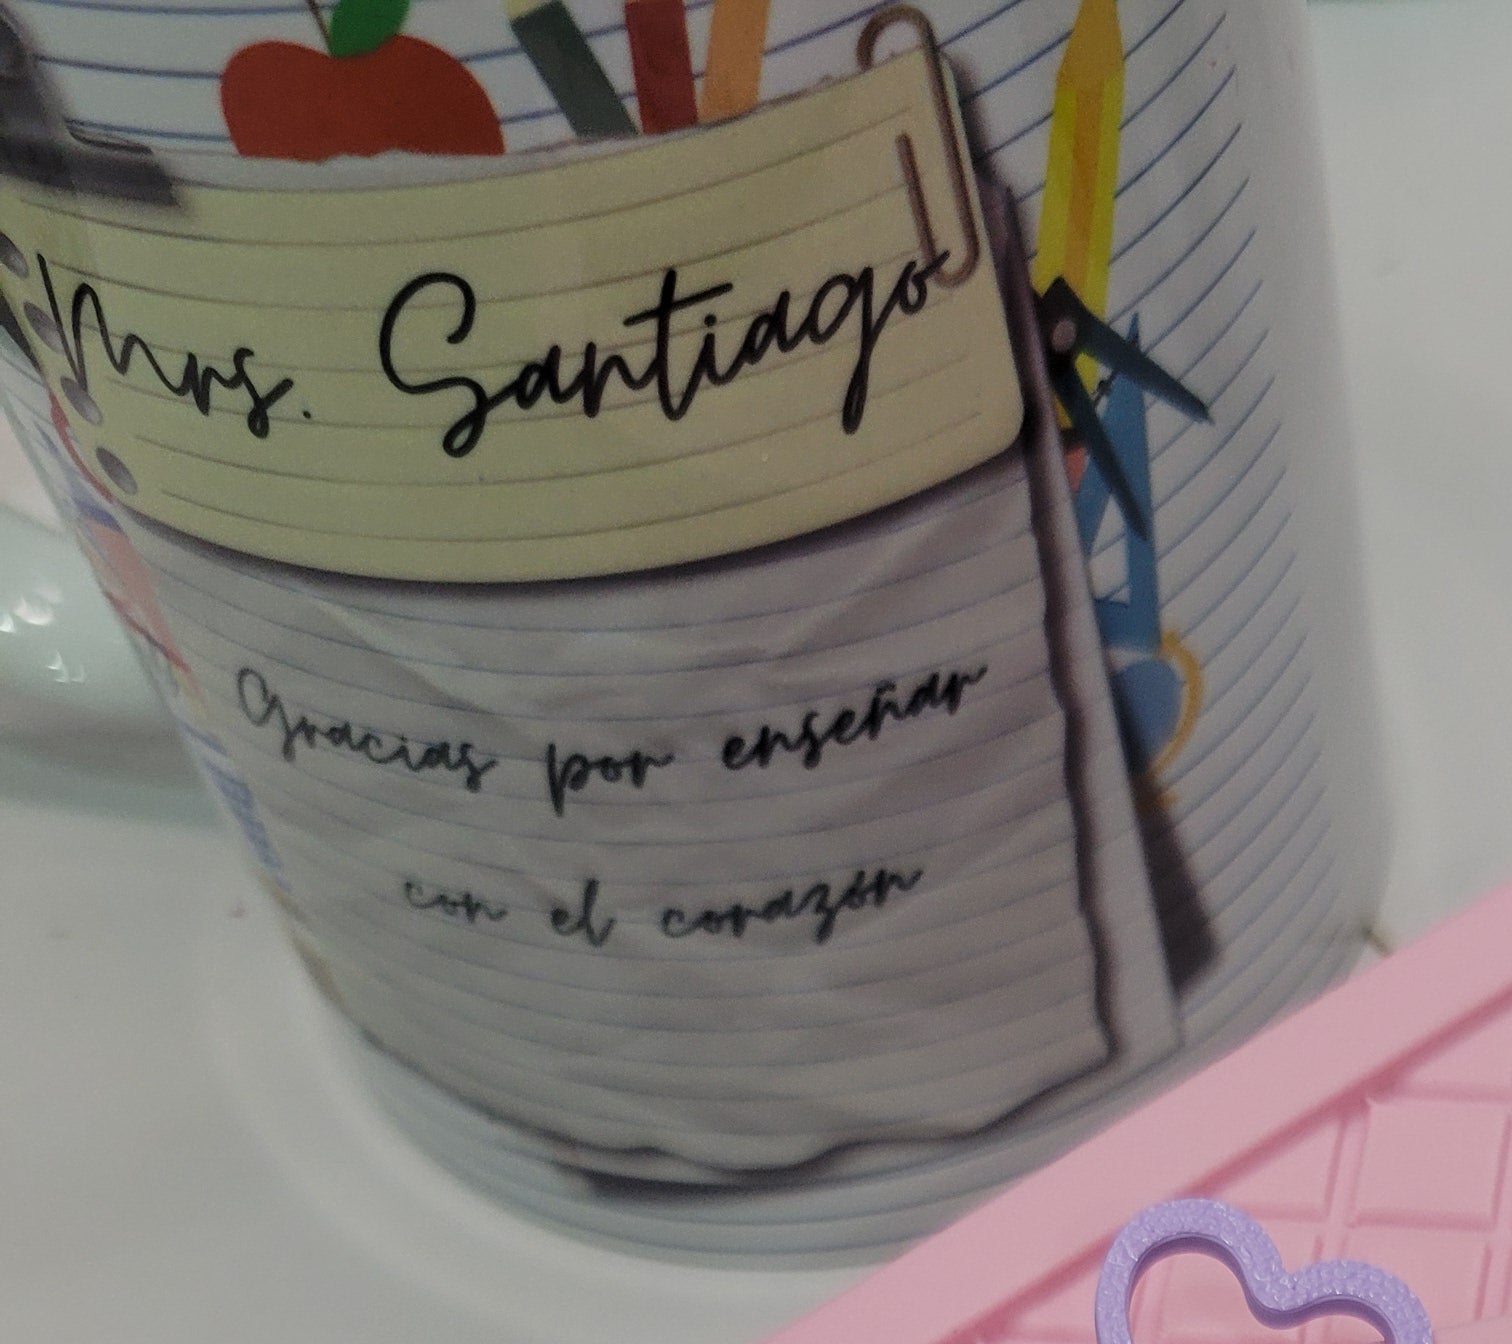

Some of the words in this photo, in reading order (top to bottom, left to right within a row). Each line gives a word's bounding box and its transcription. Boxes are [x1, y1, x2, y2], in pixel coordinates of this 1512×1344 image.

[36, 252, 312, 439] Mrs.
[379, 250, 952, 459] Santiago
[236, 666, 498, 793] Gracias
[546, 742, 676, 818] por
[721, 664, 989, 771] enseñar
[404, 880, 508, 923] con
[550, 876, 618, 948] el
[661, 867, 924, 945] corazón
